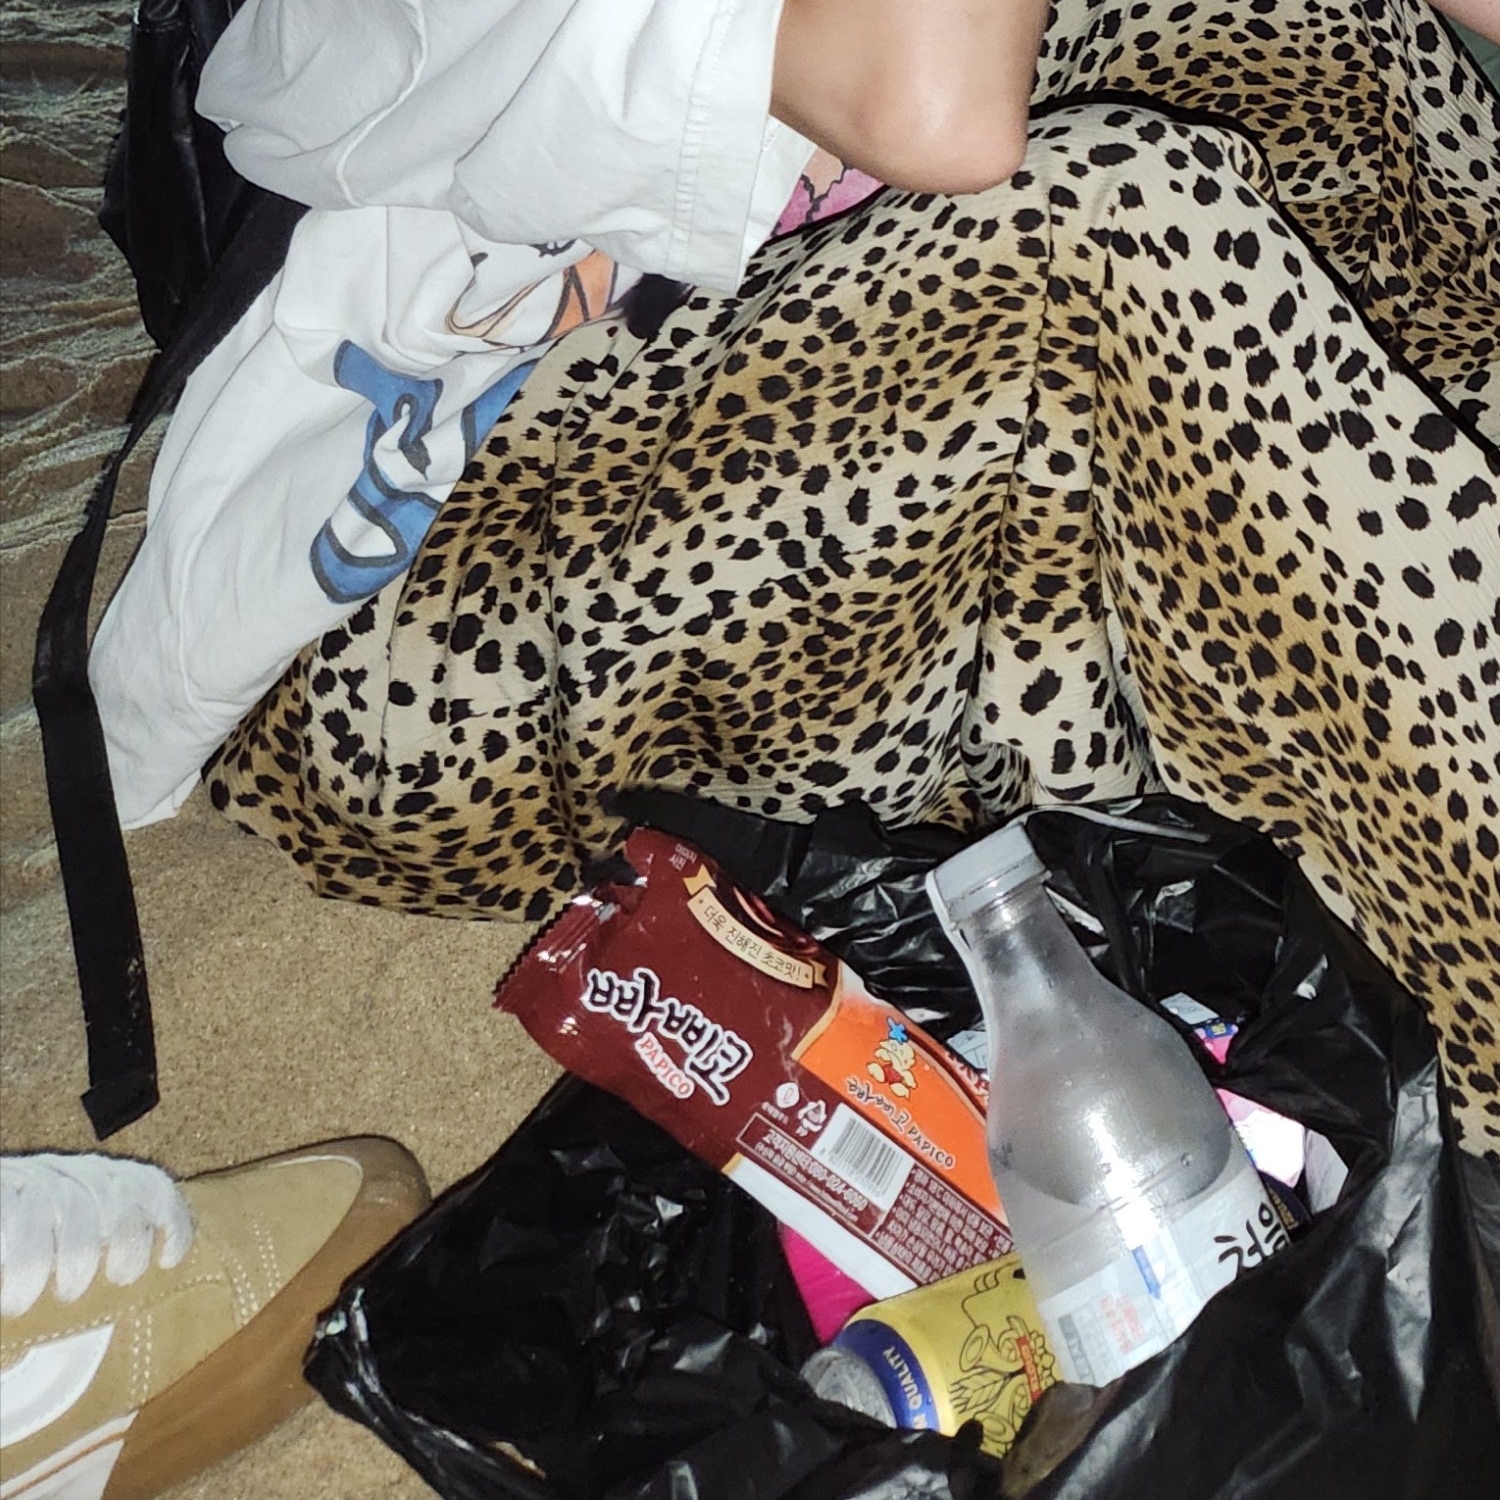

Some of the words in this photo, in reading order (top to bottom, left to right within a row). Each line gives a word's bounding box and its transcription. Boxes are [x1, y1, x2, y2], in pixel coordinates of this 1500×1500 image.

[702, 905, 727, 932] 더욱
[722, 926, 763, 959] 진해진
[761, 950, 803, 983] 초코맛!
[584, 968, 752, 1106] 빠삐코
[637, 1036, 693, 1098] PAPICO
[908, 1126, 954, 1168] PAPICO
[883, 1346, 923, 1411] QUALITY
